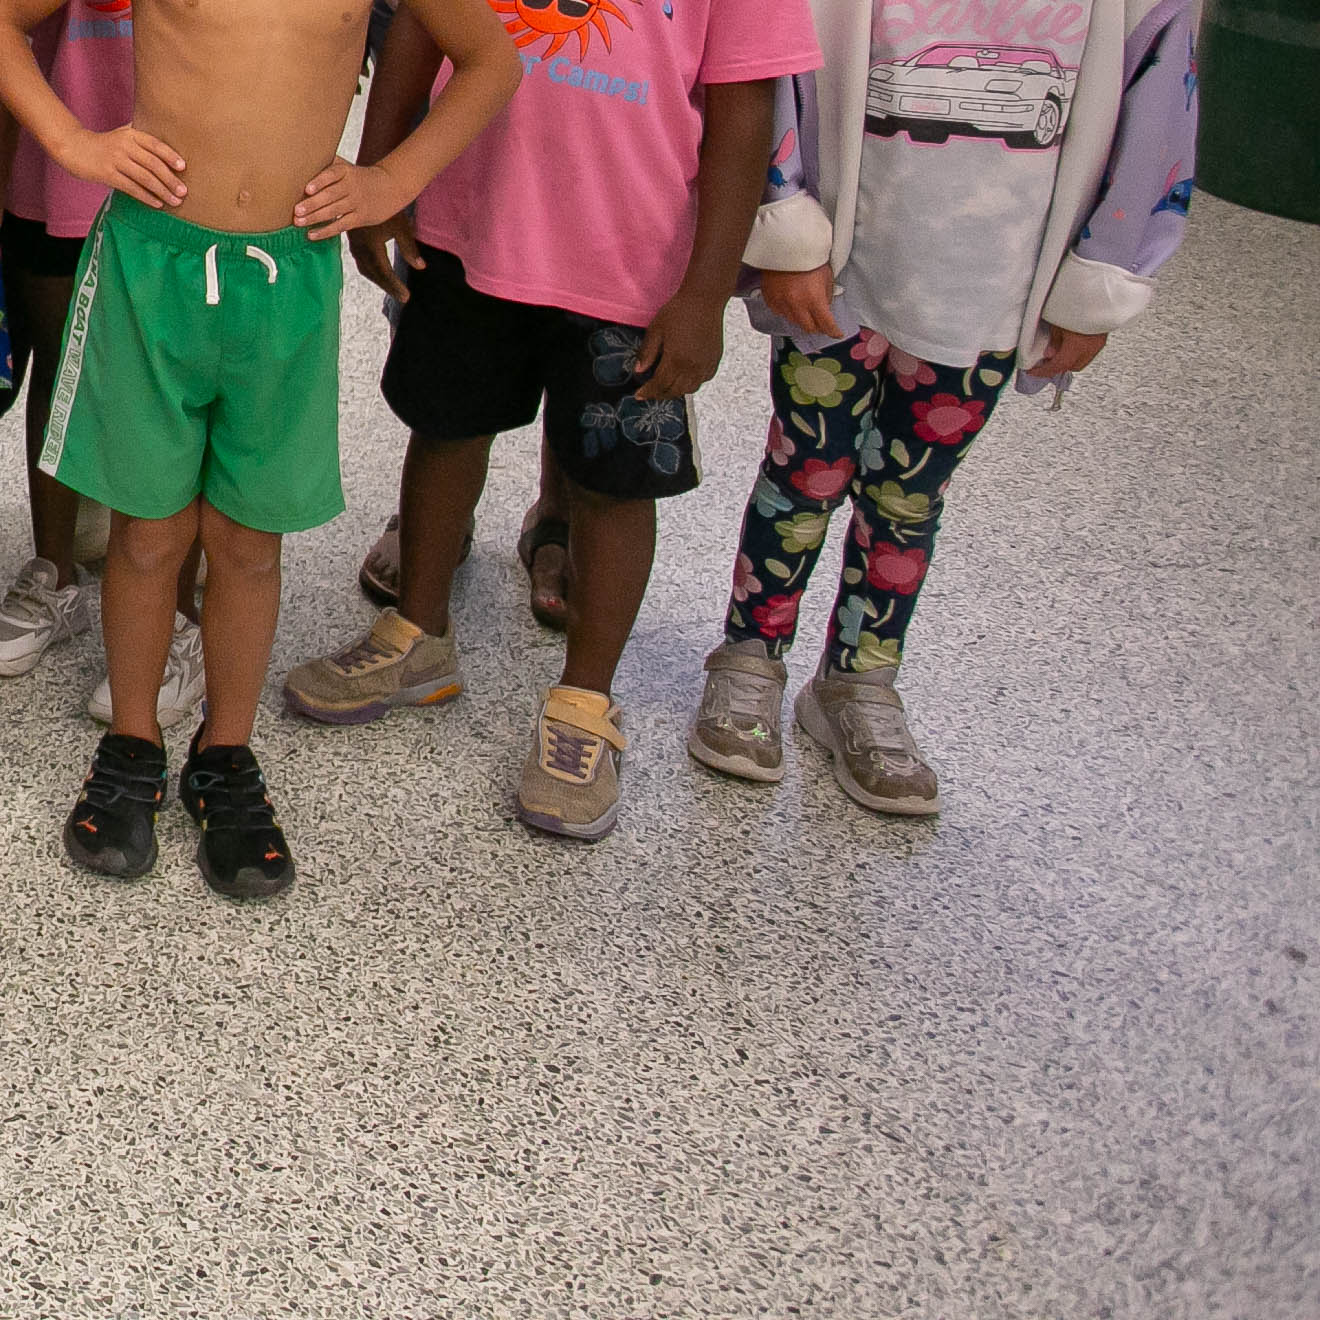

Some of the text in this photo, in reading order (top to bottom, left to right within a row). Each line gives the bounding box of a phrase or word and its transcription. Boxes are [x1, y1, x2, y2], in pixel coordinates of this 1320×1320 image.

[548, 56, 650, 105] Camps!
[72, 293, 89, 345] BOAT
[56, 346, 80, 405] WAVE
[41, 405, 67, 466] RIDER
